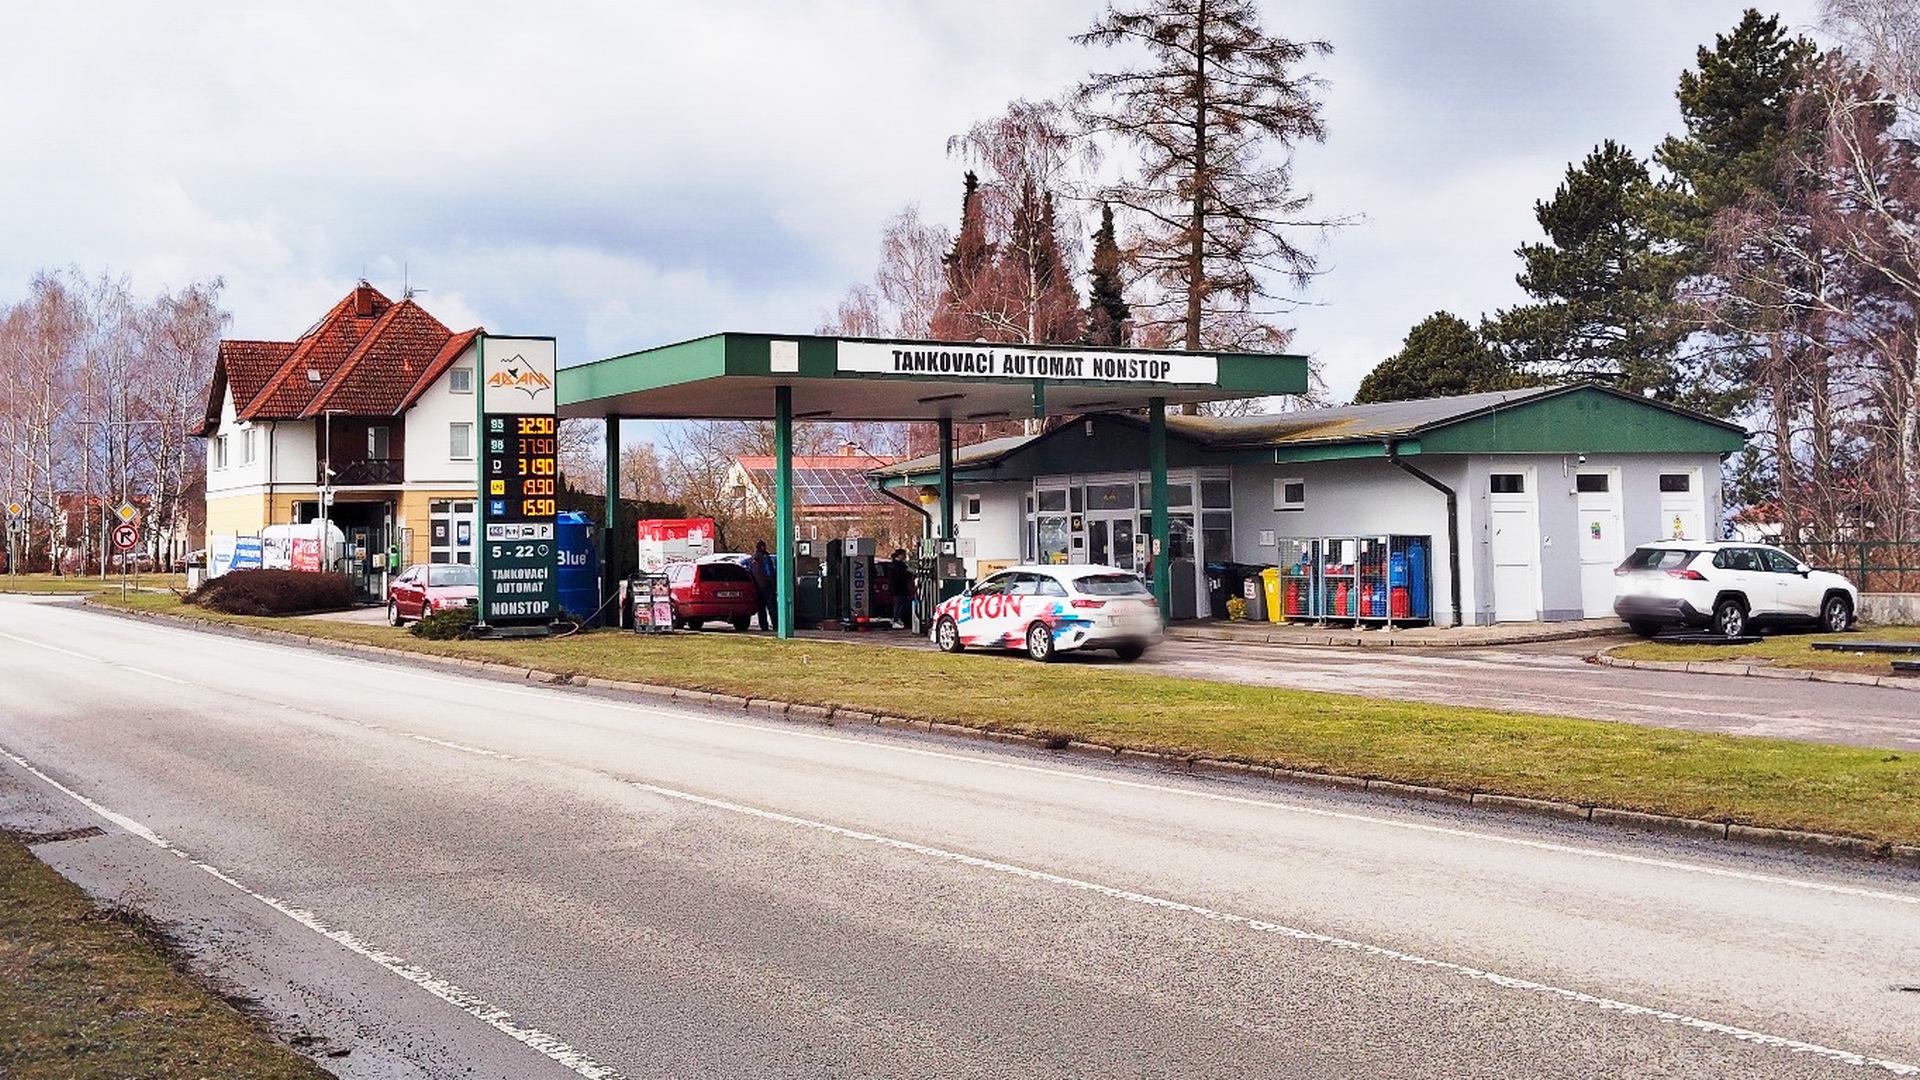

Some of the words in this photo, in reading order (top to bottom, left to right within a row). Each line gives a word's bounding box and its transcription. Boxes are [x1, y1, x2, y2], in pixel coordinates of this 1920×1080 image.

[892, 350, 994, 374] TANKOVACÍ
[1003, 354, 1084, 377] AUTOMAT
[1093, 358, 1171, 379] NONSTOP
[491, 419, 504, 429] 95
[491, 439, 504, 450] 98
[493, 460, 502, 470] D
[492, 546, 502, 558] 5
[515, 545, 534, 558] 22
[492, 567, 548, 580] TANKOVACÍ
[496, 582, 544, 594] AUTOMAT
[854, 561, 864, 608] AdBlue
[491, 601, 550, 615] NONSTOP
[946, 594, 1024, 621] HERON
